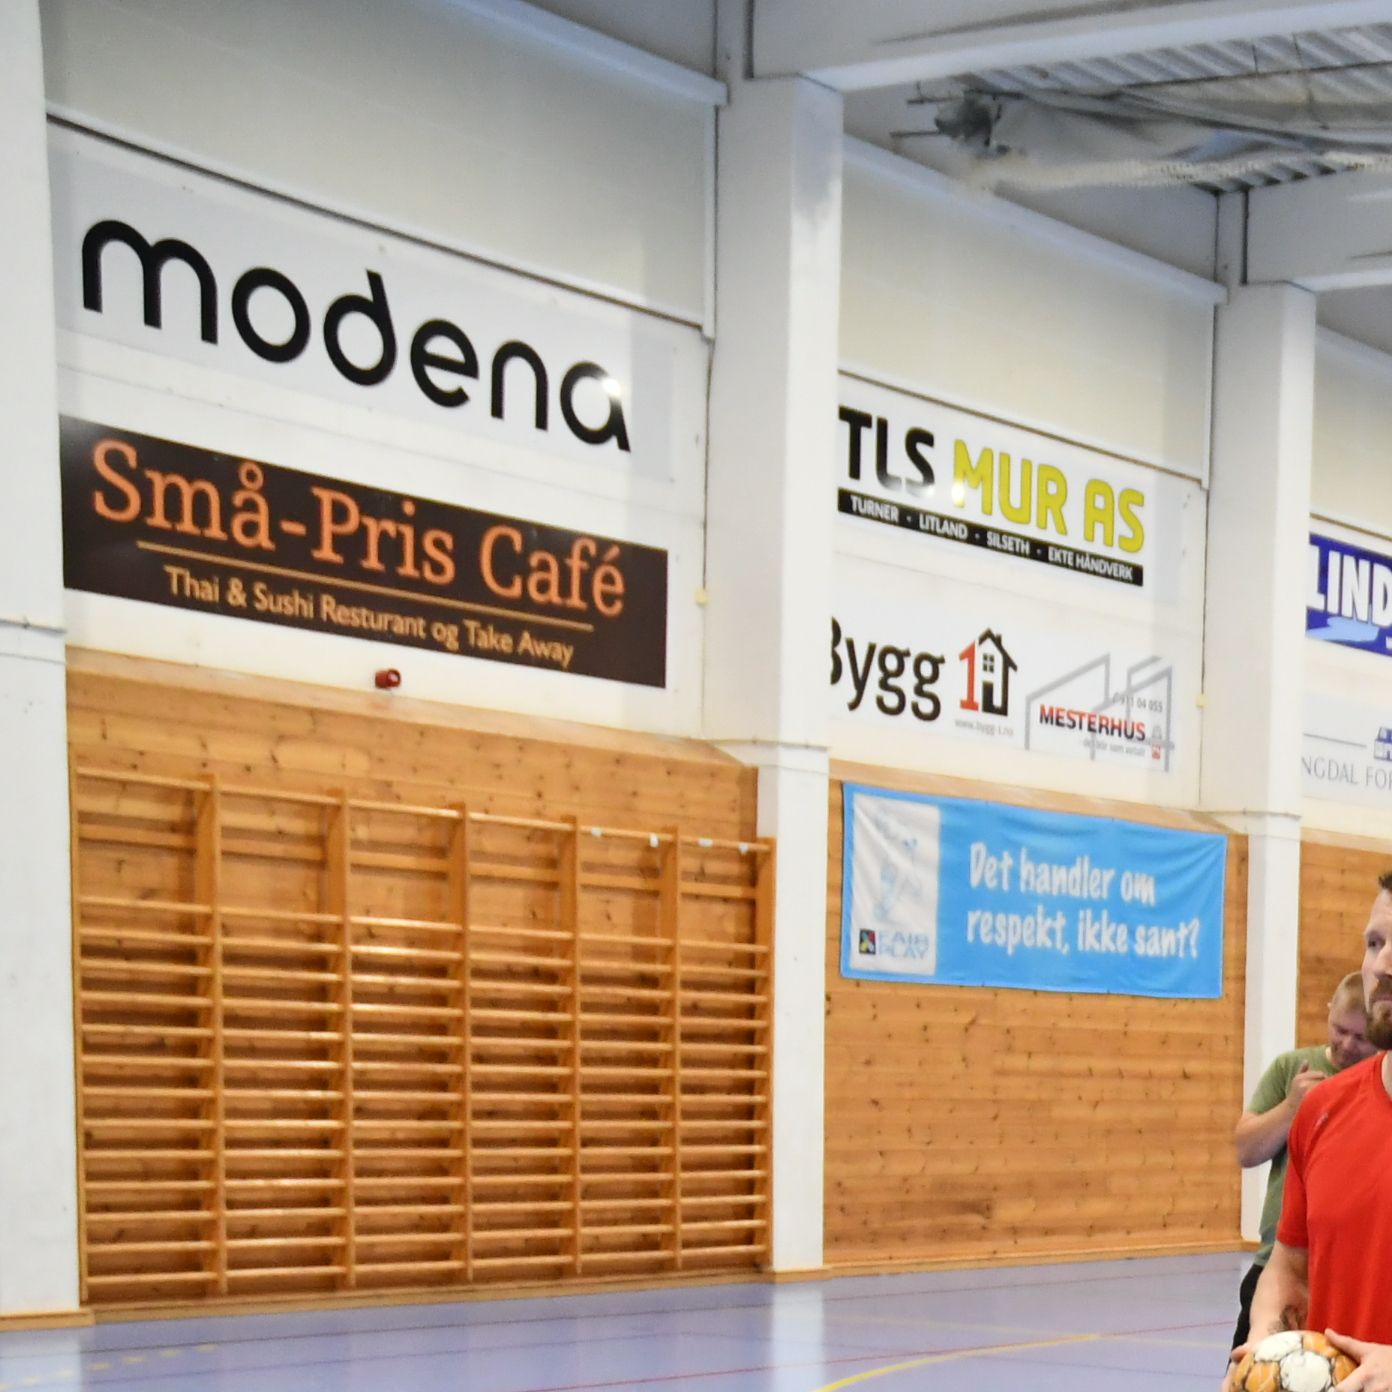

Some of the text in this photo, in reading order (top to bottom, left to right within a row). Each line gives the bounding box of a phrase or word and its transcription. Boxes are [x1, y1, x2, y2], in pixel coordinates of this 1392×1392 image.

[81, 219, 632, 453] modena
[838, 404, 1146, 554] TLS MUR AS
[92, 438, 626, 618] Små-Pris Café
[850, 496, 1133, 582] TURNER LITLAND SILSETH EKTE HÅNDVERK
[163, 564, 575, 671] Thai & Sushi Resturant og Take Away
[1039, 703, 1147, 743] MESTERHUS
[970, 842, 1156, 906] Det handler om
[967, 903, 1201, 959] respekt, ikke sant?
